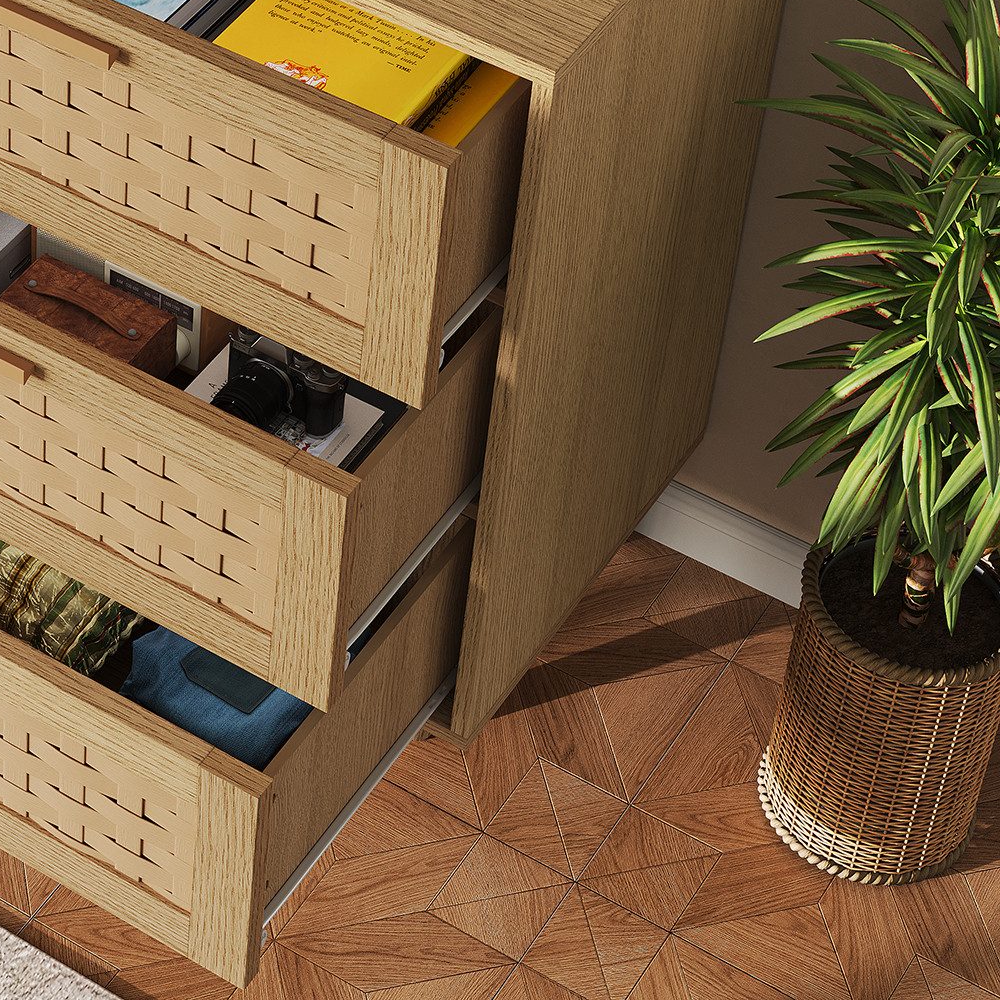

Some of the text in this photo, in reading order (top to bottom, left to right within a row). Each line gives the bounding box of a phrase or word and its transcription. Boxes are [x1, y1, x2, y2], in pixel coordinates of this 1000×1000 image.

[355, 10, 375, 21] Mark
[349, 18, 379, 31] political
[310, 10, 325, 18] and
[395, 44, 426, 60] delighted
[372, 45, 401, 58] original
